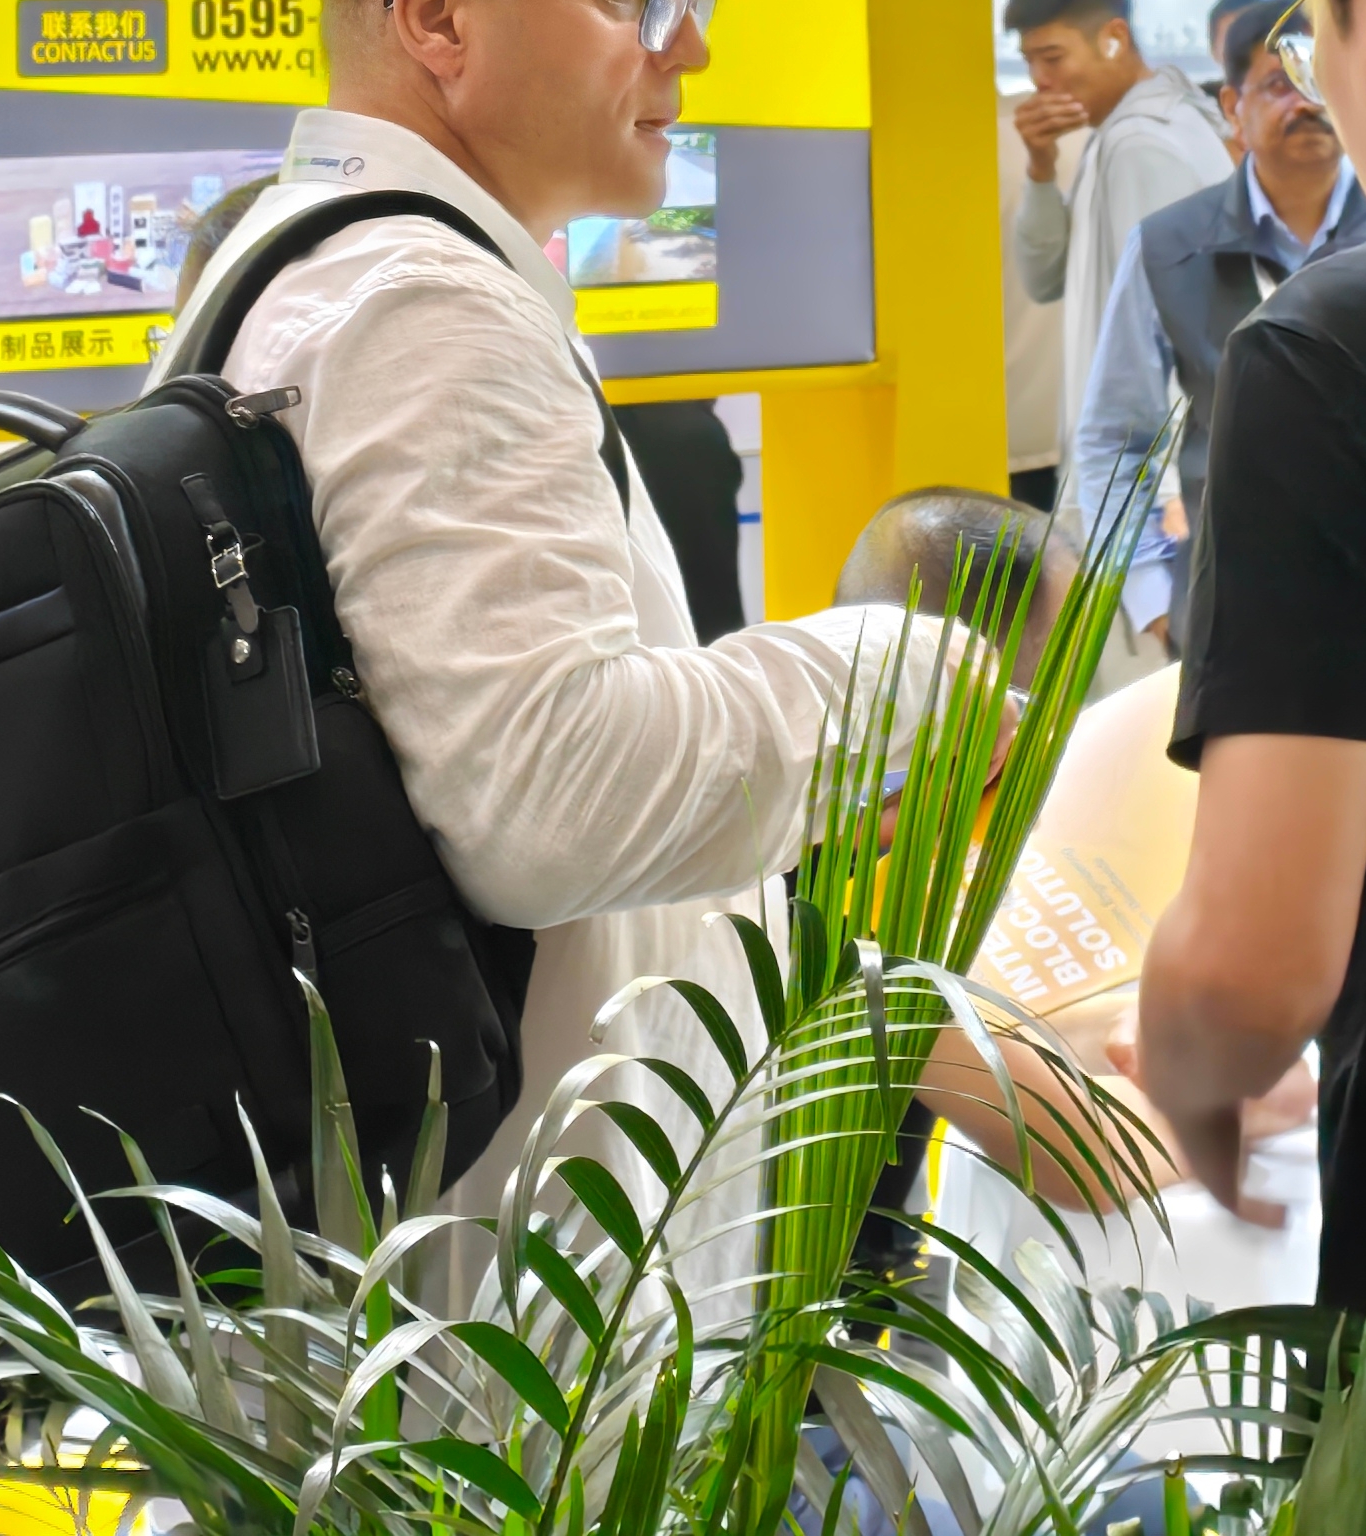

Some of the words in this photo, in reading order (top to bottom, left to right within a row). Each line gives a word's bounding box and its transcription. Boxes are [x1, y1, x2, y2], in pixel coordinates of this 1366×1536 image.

[40, 9, 147, 40] 联系我们
[31, 41, 126, 64] CONTACT
[128, 40, 156, 62] US
[0, 327, 116, 362] 制品展示
